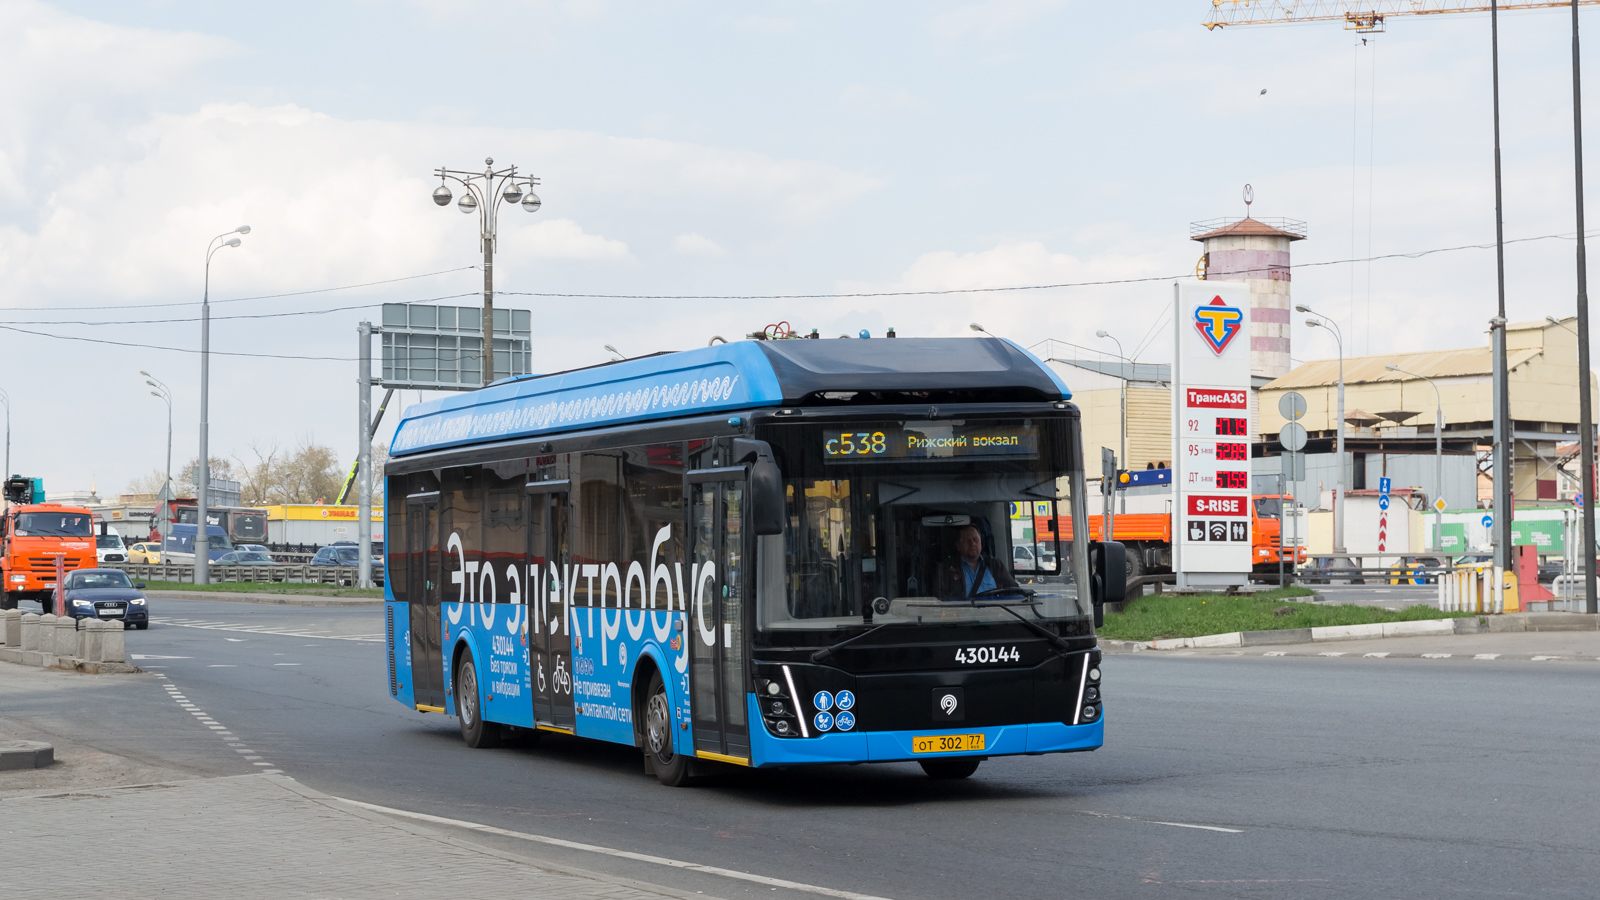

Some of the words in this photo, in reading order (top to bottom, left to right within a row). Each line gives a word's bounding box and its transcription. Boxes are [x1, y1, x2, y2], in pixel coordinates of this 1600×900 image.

[1188, 391, 1245, 405] ТрансАЗС
[1188, 419, 1199, 432] 92
[825, 431, 887, 455] с538
[908, 435, 967, 448] Рижский
[973, 436, 1018, 447] вокзал
[1188, 444, 1199, 456] 95
[1188, 472, 1199, 484] ДТ
[1196, 499, 1239, 512] S-RISE
[447, 531, 496, 631] Это
[506, 522, 732, 673] электробус.
[492, 635, 514, 656] 430144
[955, 646, 1020, 664] 430144
[490, 655, 500, 673] Без
[500, 661, 517, 682] тряски
[491, 681, 496, 693] и
[496, 679, 520, 699] вибраций
[573, 675, 583, 695] Не
[583, 681, 611, 700] привязан
[582, 702, 618, 721] контактной
[919, 740, 934, 751] ОТ
[939, 736, 962, 750] 302
[969, 735, 981, 745] 77
